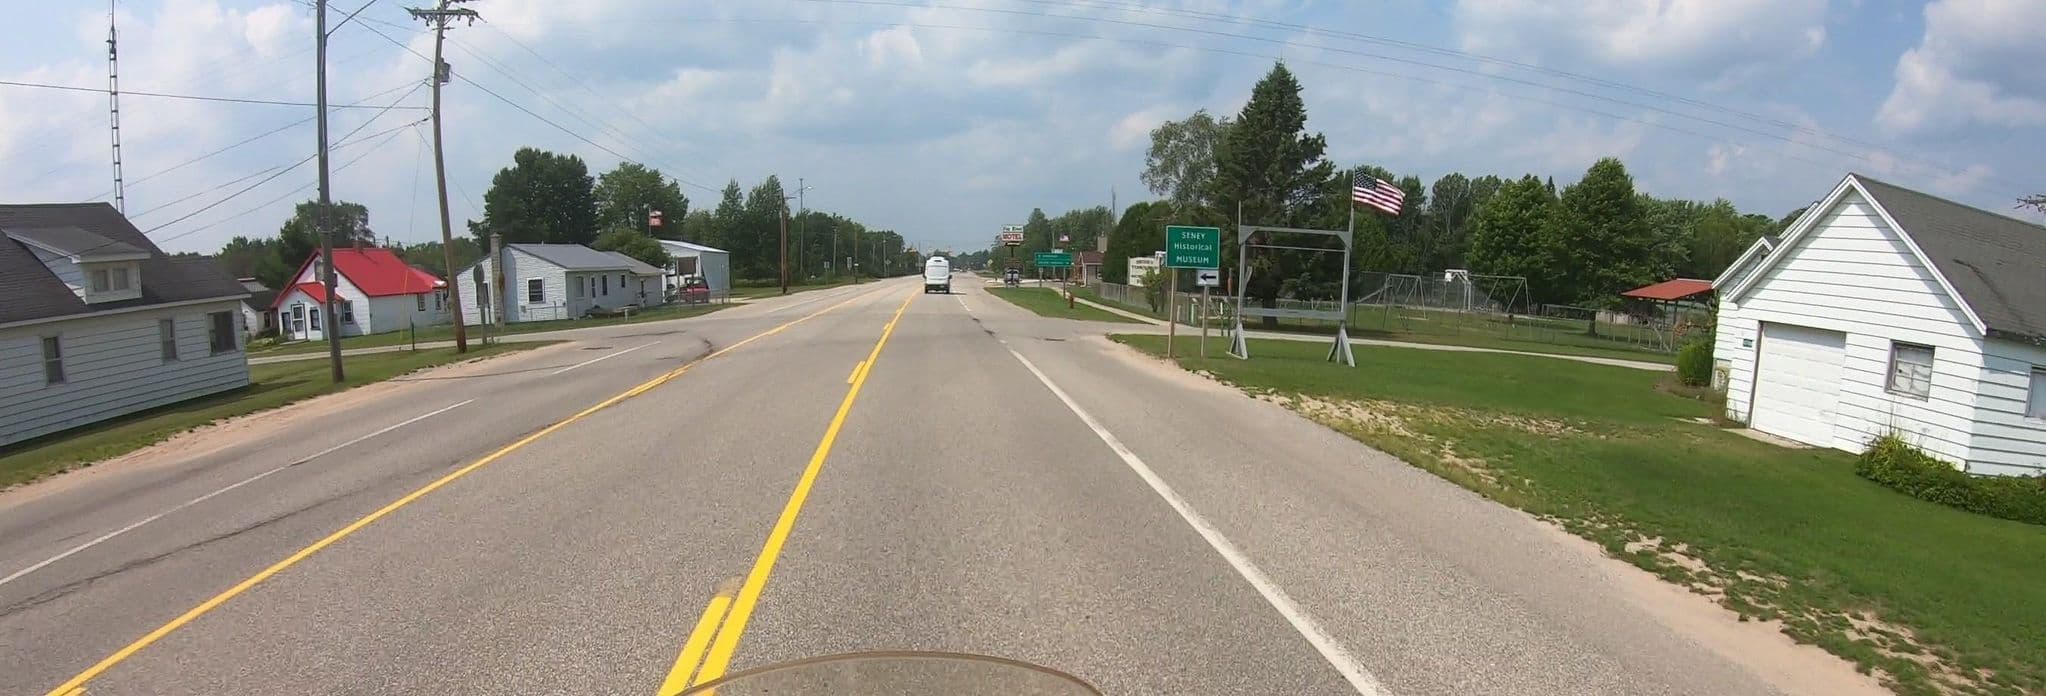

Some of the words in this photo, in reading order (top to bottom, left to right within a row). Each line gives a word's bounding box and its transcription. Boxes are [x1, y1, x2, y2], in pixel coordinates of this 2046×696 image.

[1182, 232, 1206, 240] SENEY
[1174, 243, 1212, 251] Historical
[1176, 255, 1209, 264] MUSEUM
